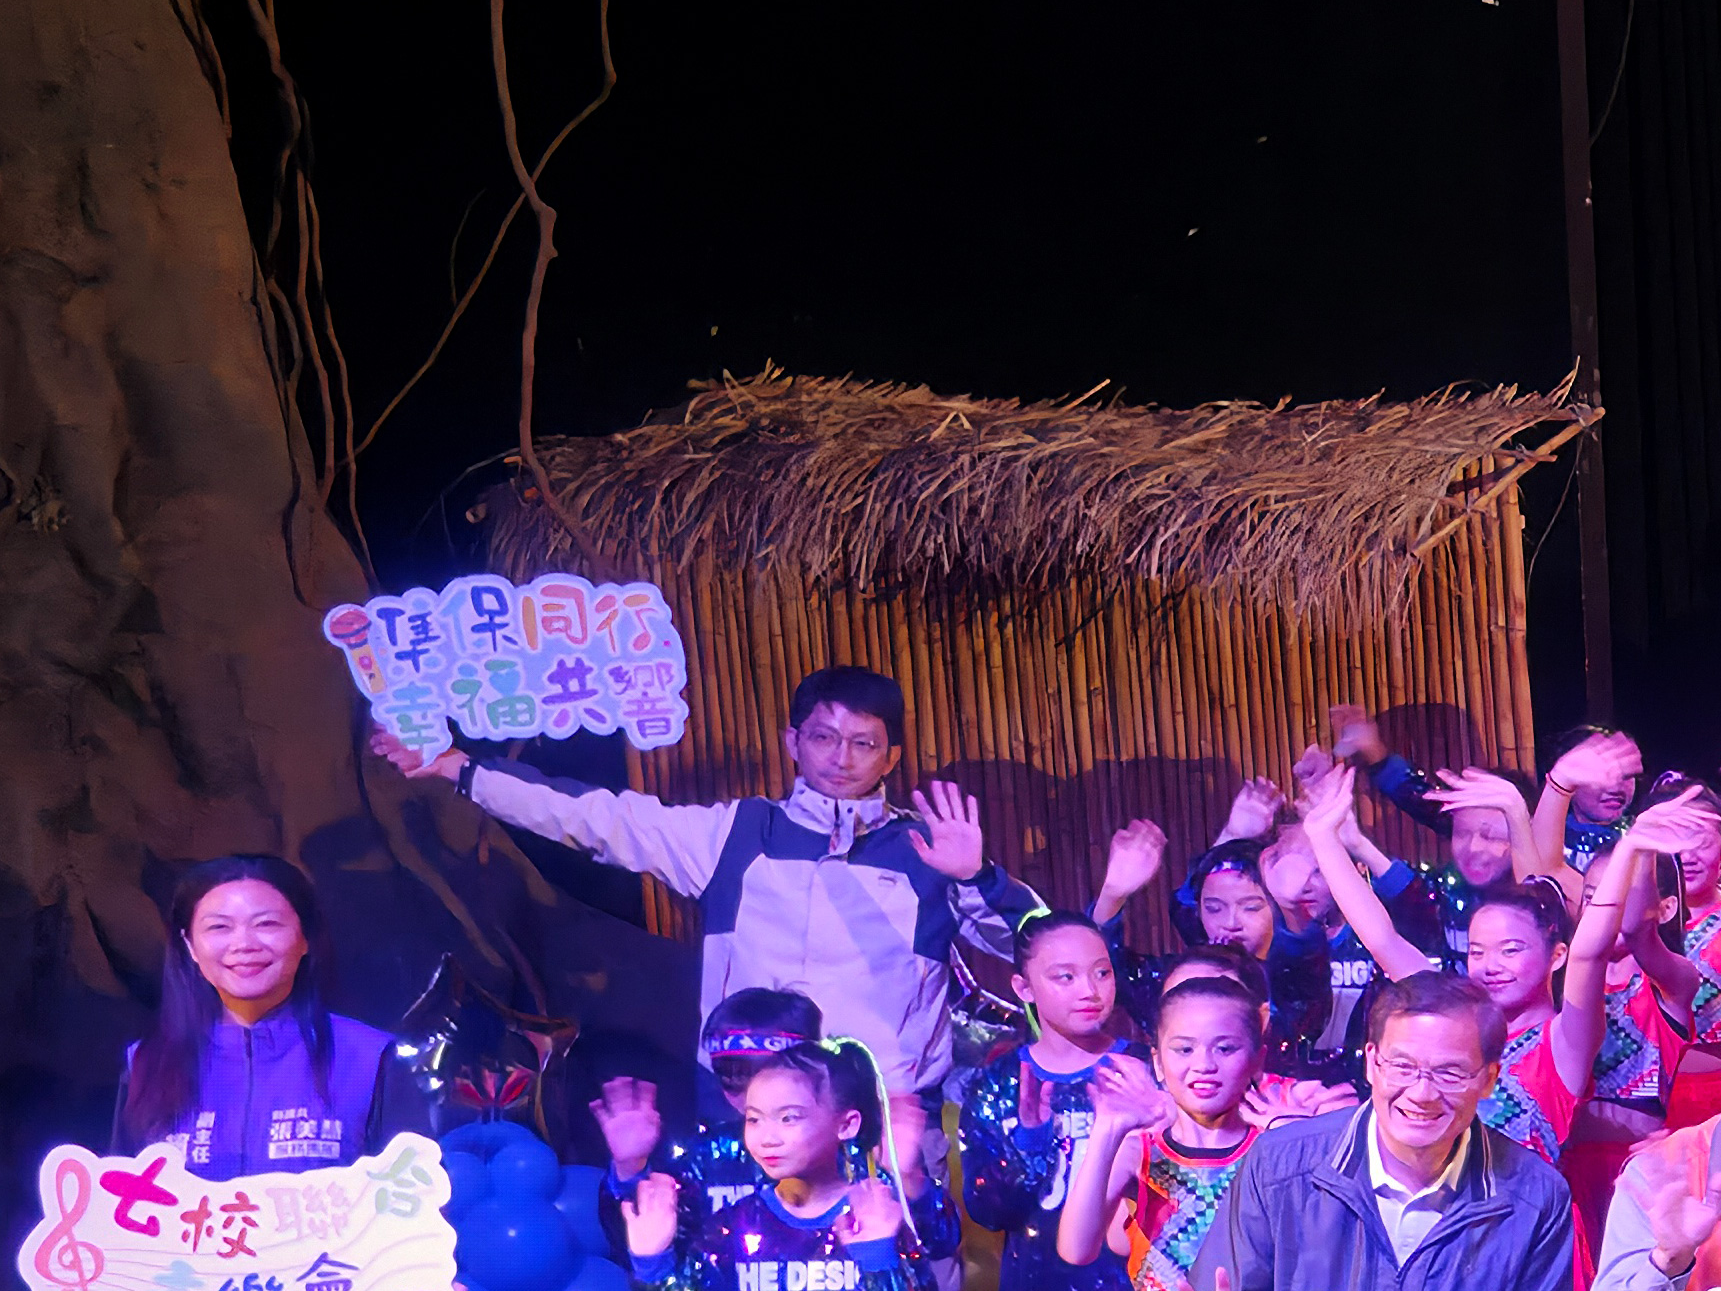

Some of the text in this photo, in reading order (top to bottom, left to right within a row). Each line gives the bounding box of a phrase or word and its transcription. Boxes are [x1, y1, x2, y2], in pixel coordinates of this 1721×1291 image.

[376, 585, 658, 675] 集保同行
[386, 657, 674, 747] 幸福共響
[100, 1155, 434, 1257] 七校聯合
